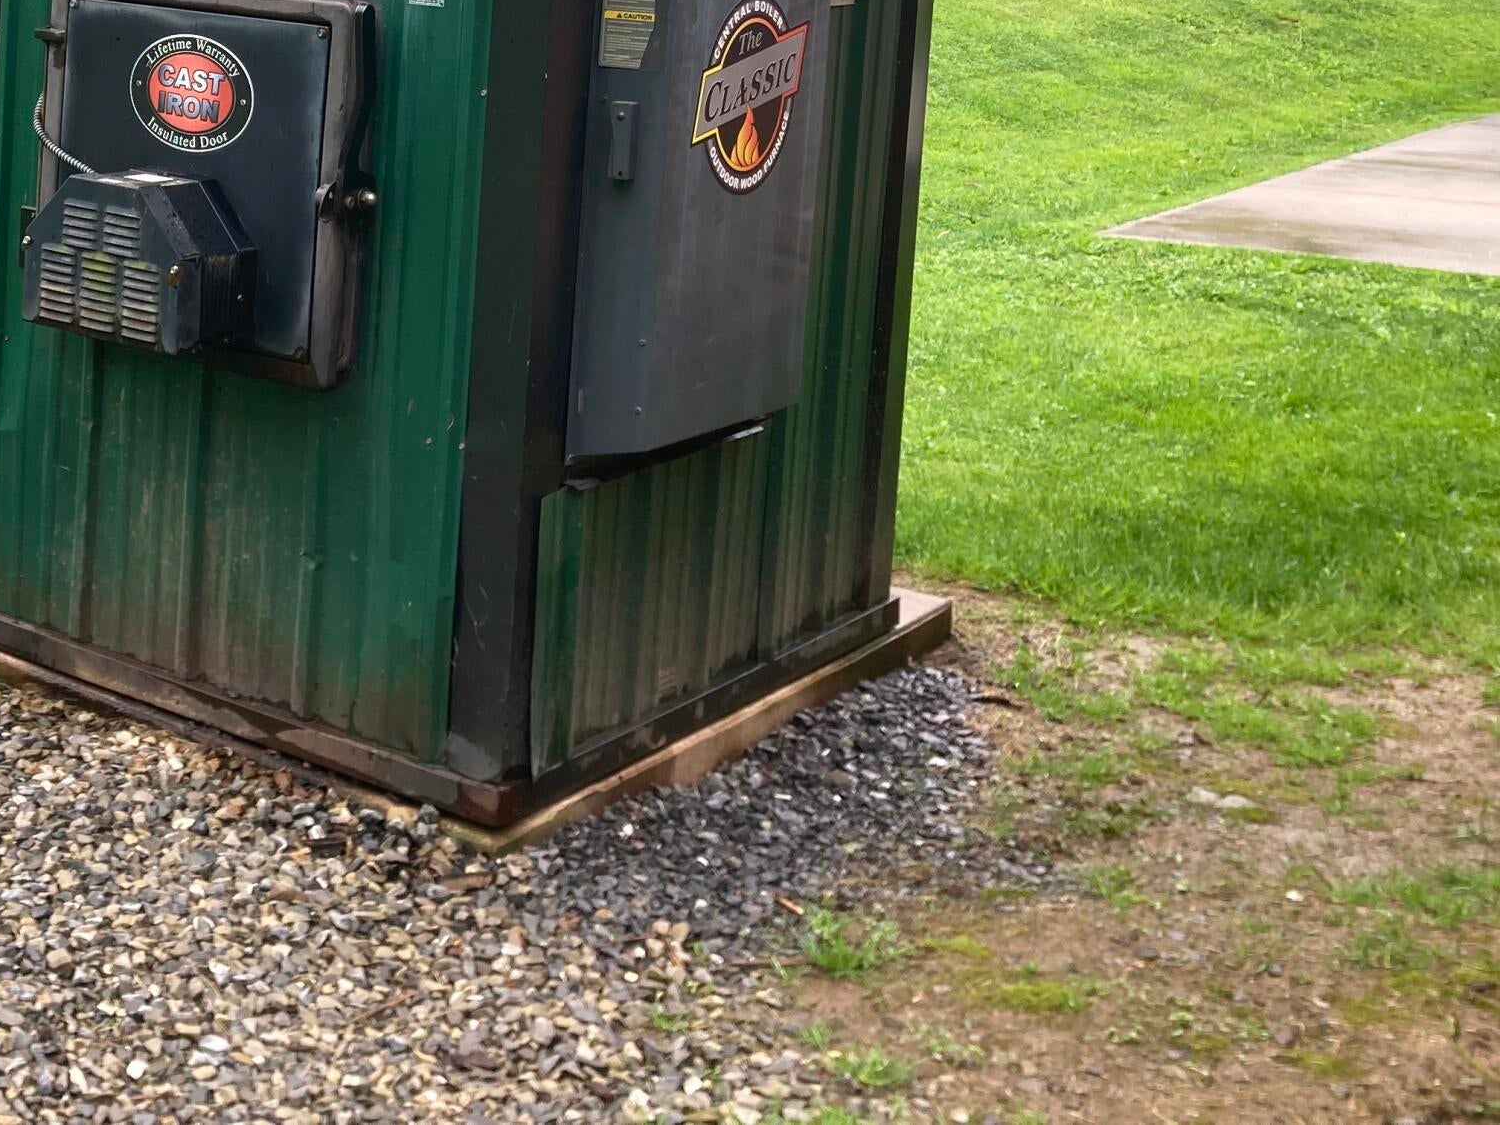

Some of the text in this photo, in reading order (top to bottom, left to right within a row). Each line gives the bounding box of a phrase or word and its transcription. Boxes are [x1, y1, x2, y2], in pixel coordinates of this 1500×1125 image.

[623, 13, 653, 21] CAUTION
[714, 0, 783, 59] CENTRAL BOILER
[146, 39, 240, 77] Lifetime Warranty
[739, 30, 763, 55] The
[158, 63, 225, 96] CAST
[704, 53, 798, 123] CLASSIC
[157, 90, 220, 124] IRON
[147, 116, 228, 148] Insulated Door
[710, 111, 789, 189] OUTDOOR WOOD FURNACE
